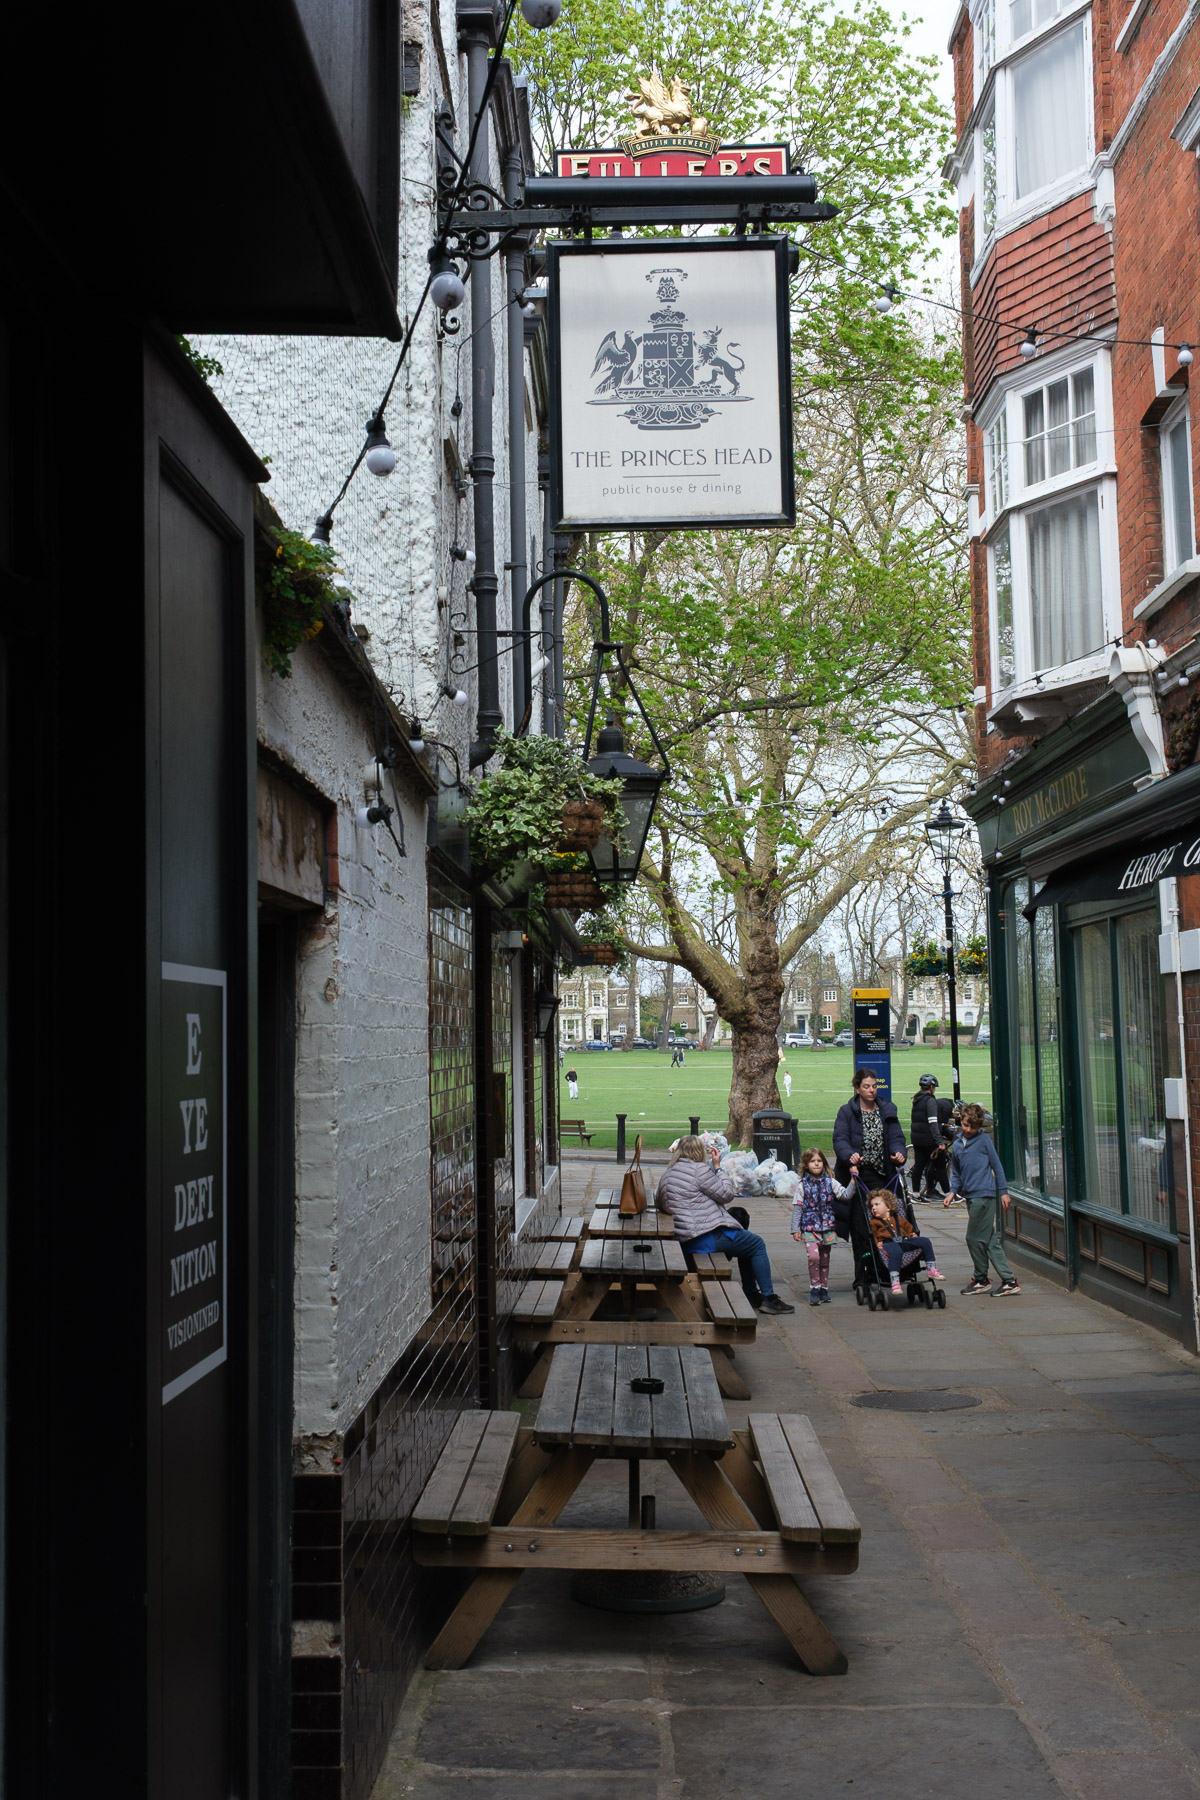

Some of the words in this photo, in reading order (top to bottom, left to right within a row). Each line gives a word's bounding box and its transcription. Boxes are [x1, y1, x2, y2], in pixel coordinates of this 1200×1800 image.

[635, 139, 668, 151] GRIFFIN
[571, 450, 612, 468] THE
[621, 448, 707, 467] PRINCES
[714, 447, 773, 465] HEAD
[602, 483, 641, 497] public
[646, 484, 683, 494] house
[688, 483, 697, 493] &
[702, 482, 742, 495] dining
[1012, 797, 1035, 836] ROY
[186, 1012, 202, 1075] E
[180, 1097, 209, 1155] YE
[174, 1174, 214, 1233] DEFI
[170, 1239, 217, 1297] NITION
